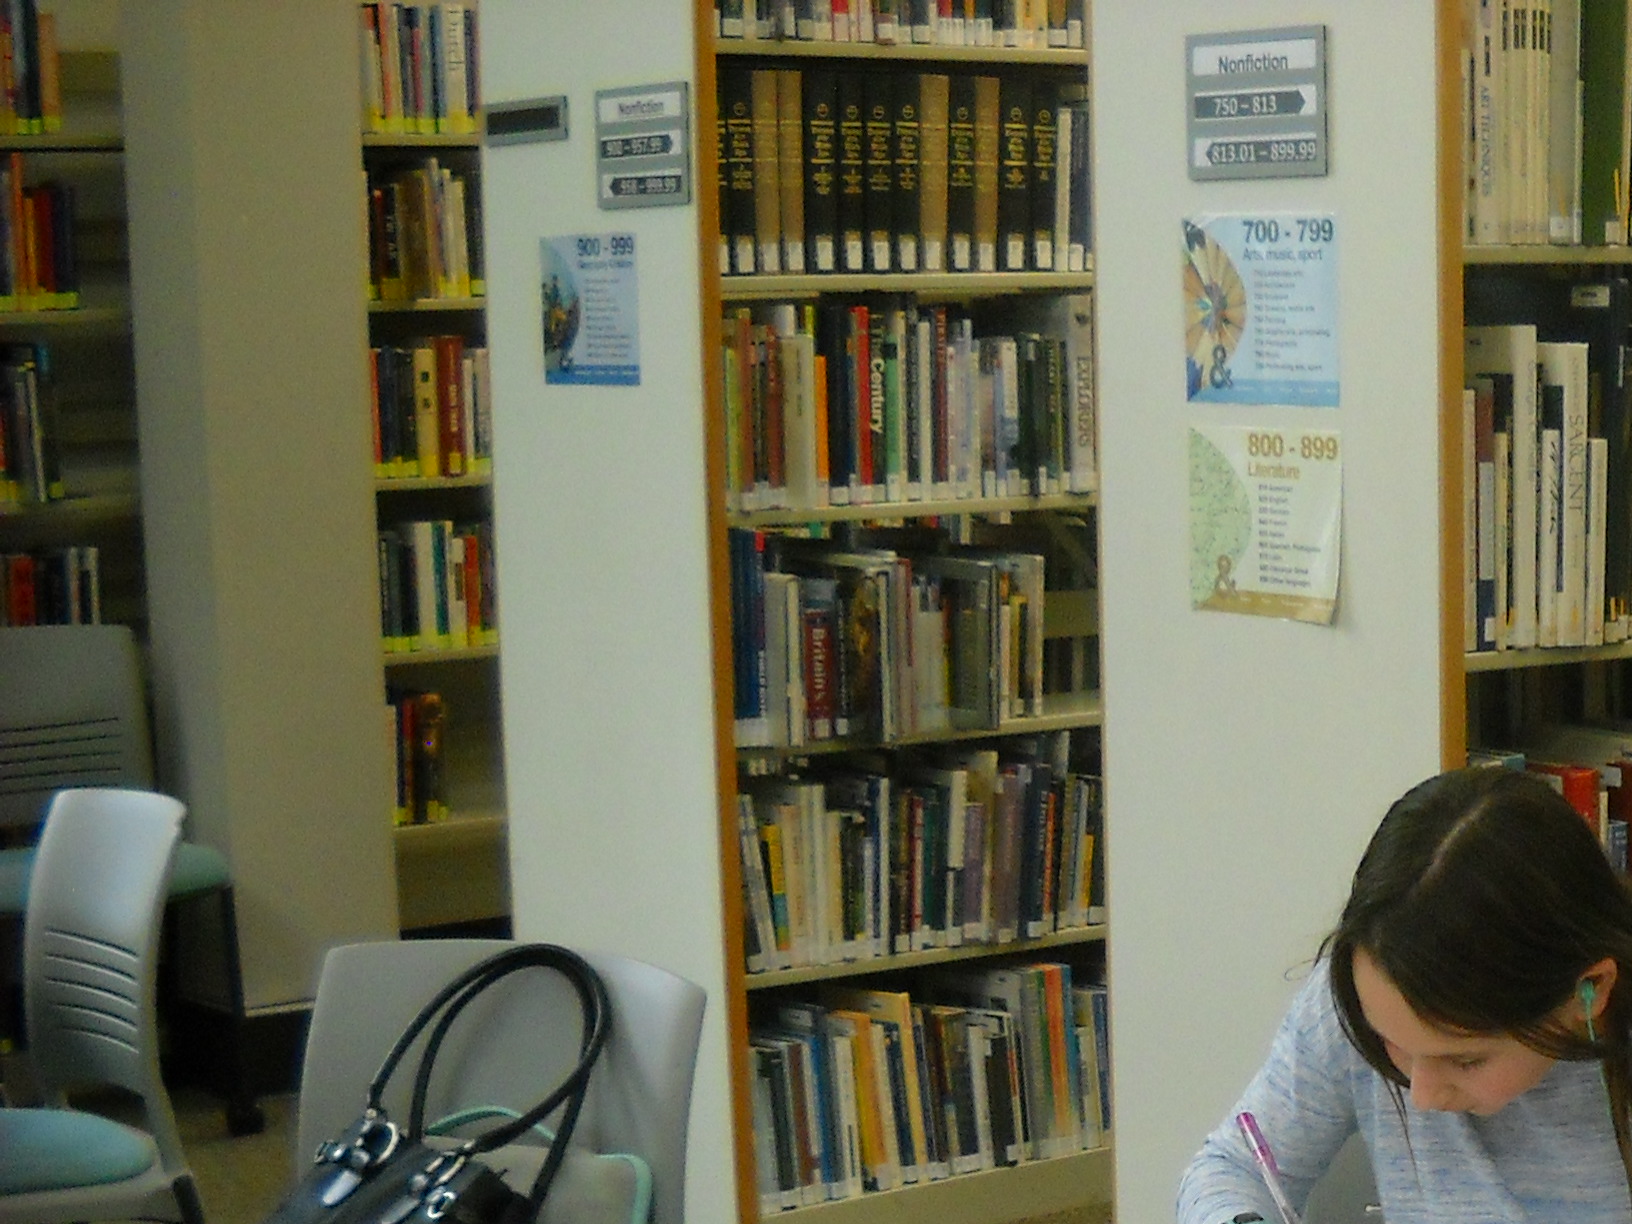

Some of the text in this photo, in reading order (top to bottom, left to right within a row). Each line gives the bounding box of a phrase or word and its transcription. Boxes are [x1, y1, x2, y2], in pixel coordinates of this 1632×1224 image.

[1218, 53, 1288, 74] Nonfiction
[1215, 98, 1237, 115] 750
[1252, 95, 1277, 113] 813
[1270, 142, 1316, 160] 899.99
[1481, 115, 1493, 197] TECHNIQUES
[1242, 219, 1279, 243] 700
[1296, 218, 1333, 242] 799
[611, 237, 633, 255] 999
[870, 357, 885, 433] Century
[1248, 432, 1284, 458] 800
[1301, 436, 1338, 460] 899
[1248, 462, 1300, 479] Literature
[1568, 415, 1584, 514] SARGENT
